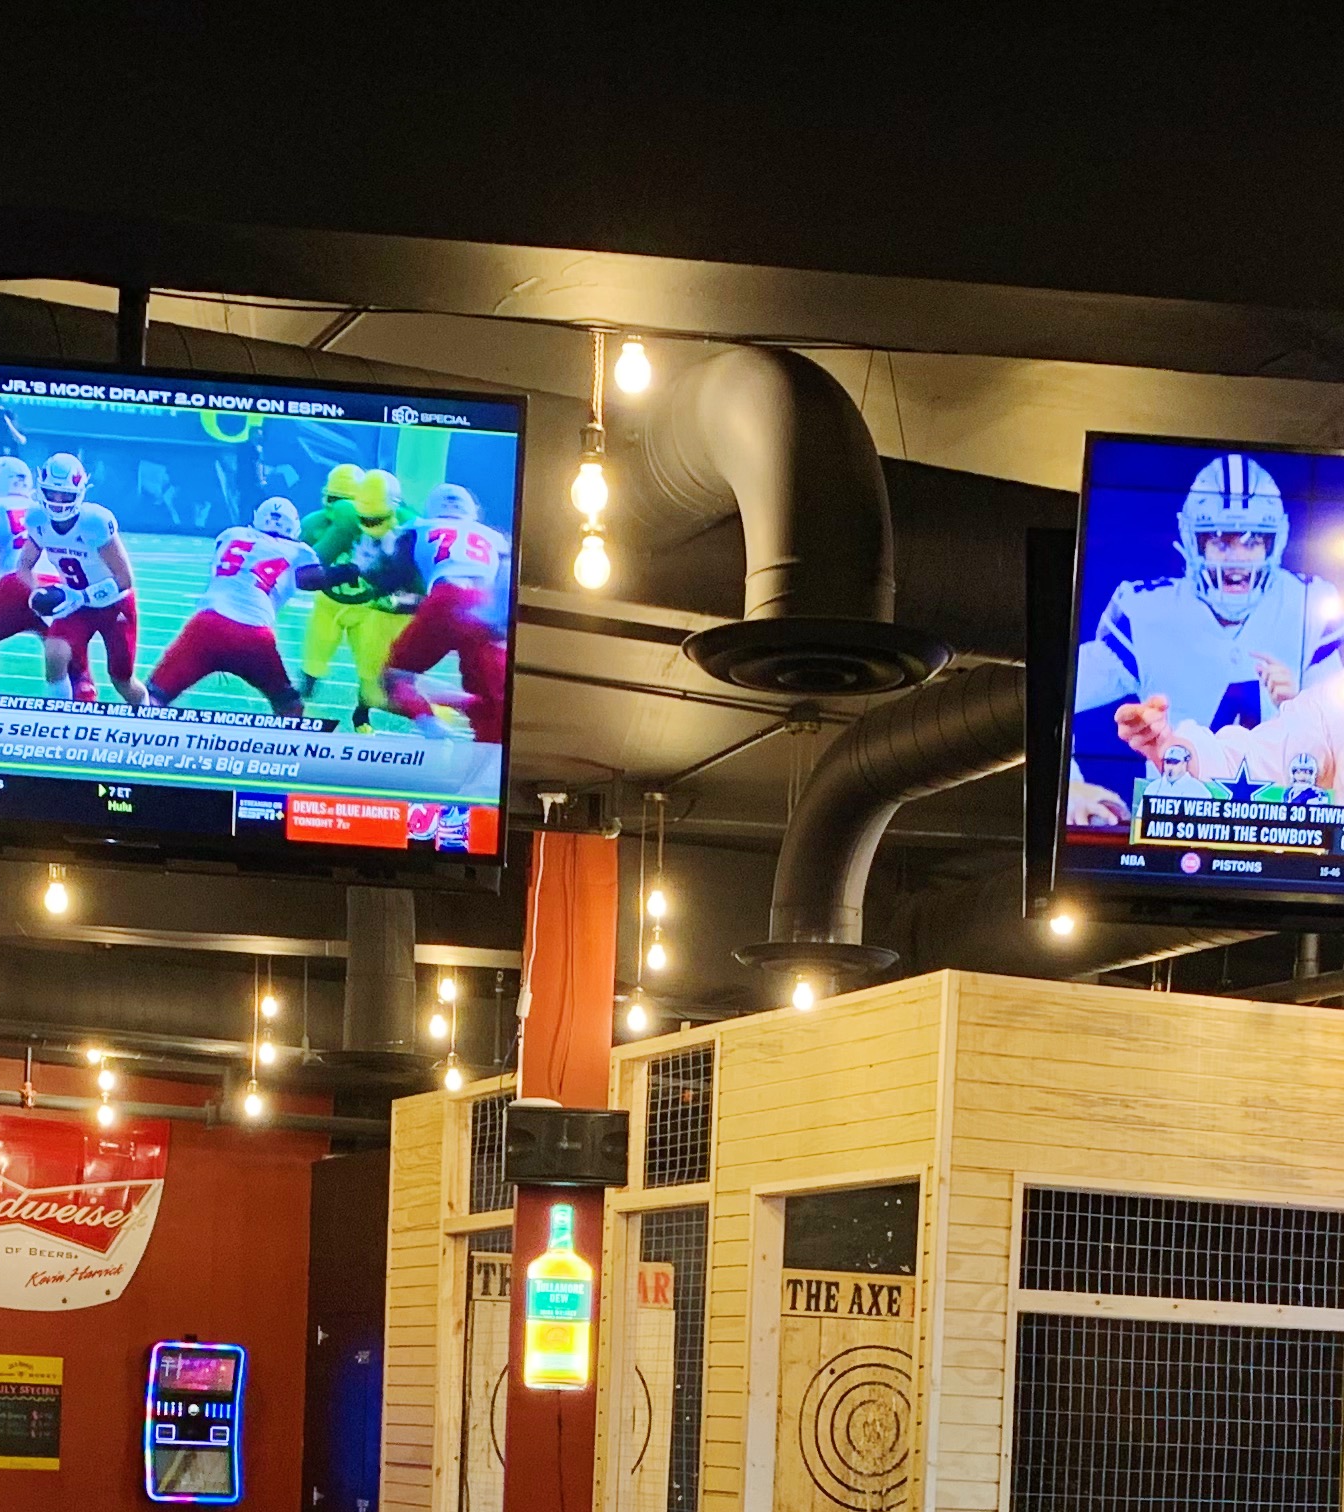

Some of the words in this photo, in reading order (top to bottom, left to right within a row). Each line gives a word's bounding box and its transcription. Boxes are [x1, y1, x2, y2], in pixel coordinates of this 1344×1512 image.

[2, 377, 47, 395] JR.'S
[50, 382, 105, 399] MOCK
[109, 387, 171, 404] DRAFT
[174, 391, 205, 406] 2.0
[208, 394, 254, 410] NOW
[257, 398, 284, 413] ON
[287, 400, 344, 417] ESPN+
[420, 412, 470, 426] SPECIAL
[58, 557, 90, 590] 9
[45, 699, 106, 715] SPECIAL:
[106, 703, 135, 718] MEL
[136, 705, 178, 721] KIPER
[178, 708, 213, 723] JR.'S
[213, 712, 254, 727] MOCK
[254, 715, 300, 730] DRAFT
[300, 718, 324, 732] 2.0
[7, 719, 73, 740] select
[74, 726, 101, 742] DE
[104, 727, 179, 752] Kayvon
[186, 733, 301, 757] Thibodeaux
[303, 743, 336, 760] No.
[339, 746, 354, 761] 5
[356, 748, 426, 766] overall
[66, 748, 89, 762] on
[90, 747, 124, 764] Mel
[125, 748, 174, 769] Kiper
[174, 754, 213, 771] Jr.'s
[214, 757, 244, 776] Big
[246, 761, 301, 777] Board
[108, 786, 116, 798] 7
[116, 787, 132, 798] ET
[107, 800, 133, 814] Hulu
[292, 800, 327, 816] DEVILS
[335, 804, 361, 818] BLUE
[360, 805, 401, 821] JACKETS
[1149, 798, 1182, 816] THEY
[1183, 799, 1221, 818] WERE
[1223, 802, 1288, 821] SHOOTING
[1289, 805, 1307, 822] 30
[292, 816, 334, 828] TONIGHT
[1146, 820, 1174, 838] AND
[1176, 822, 1194, 839] SO
[1197, 823, 1231, 841] WITH
[1232, 825, 1257, 842] THE
[1259, 828, 1323, 846] COWBOYS
[1120, 854, 1146, 867] NBA
[1212, 859, 1262, 873] PISTONS
[534, 1279, 585, 1295] TULLAMORE
[549, 1293, 569, 1304] DEW
[786, 1278, 840, 1314] THE
[847, 1282, 902, 1317] AXE
[19, 1385, 60, 1396] SPECIALS
